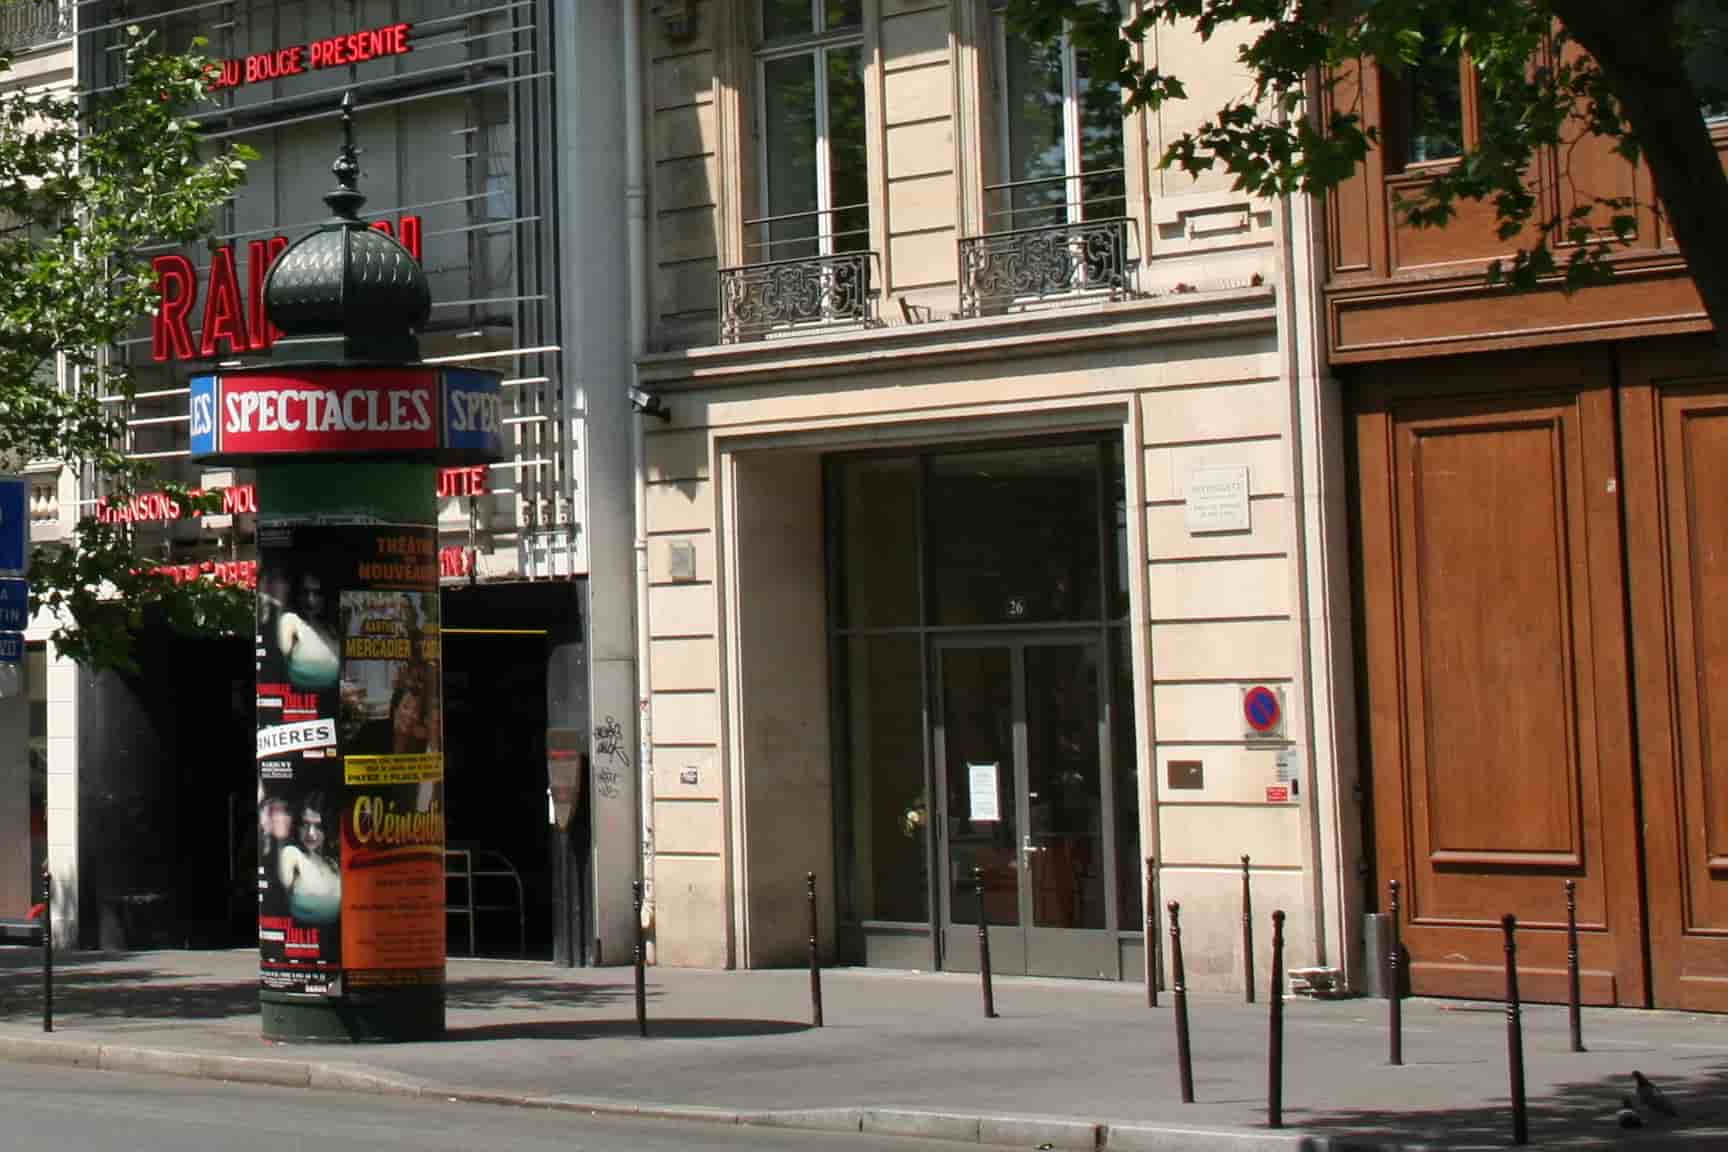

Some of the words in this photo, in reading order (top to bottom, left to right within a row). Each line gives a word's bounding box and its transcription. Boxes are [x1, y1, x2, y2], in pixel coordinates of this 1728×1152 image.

[310, 23, 410, 67] PRESENTE
[225, 389, 432, 434] SPECTACLES
[1008, 600, 1024, 615] 26
